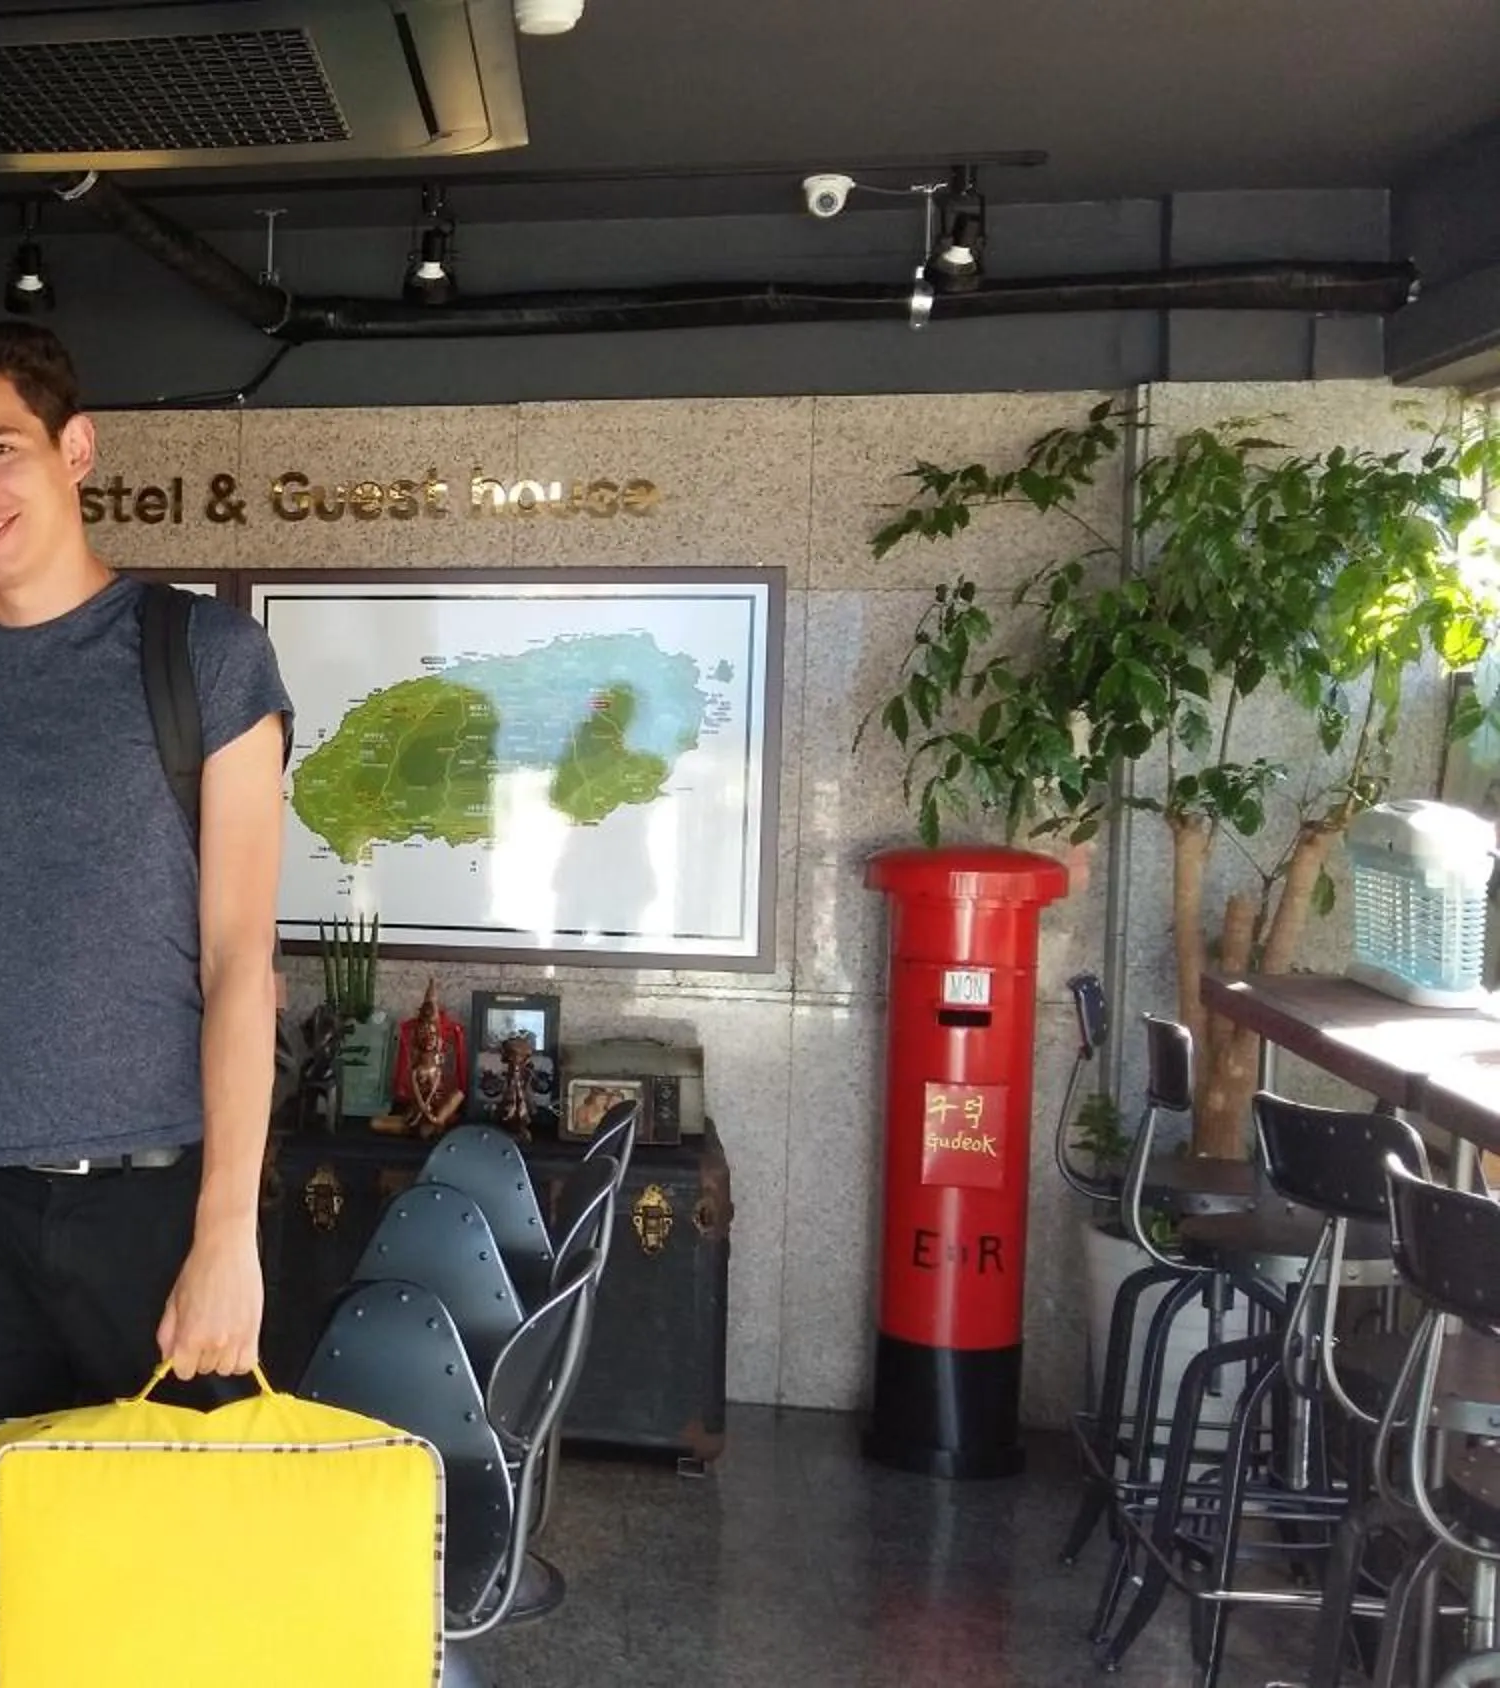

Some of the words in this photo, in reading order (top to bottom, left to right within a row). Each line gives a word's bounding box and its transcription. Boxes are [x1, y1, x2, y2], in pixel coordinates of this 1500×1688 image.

[80, 475, 183, 525] stel
[206, 473, 248, 525] &
[272, 471, 448, 522] Guest
[470, 466, 660, 520] house
